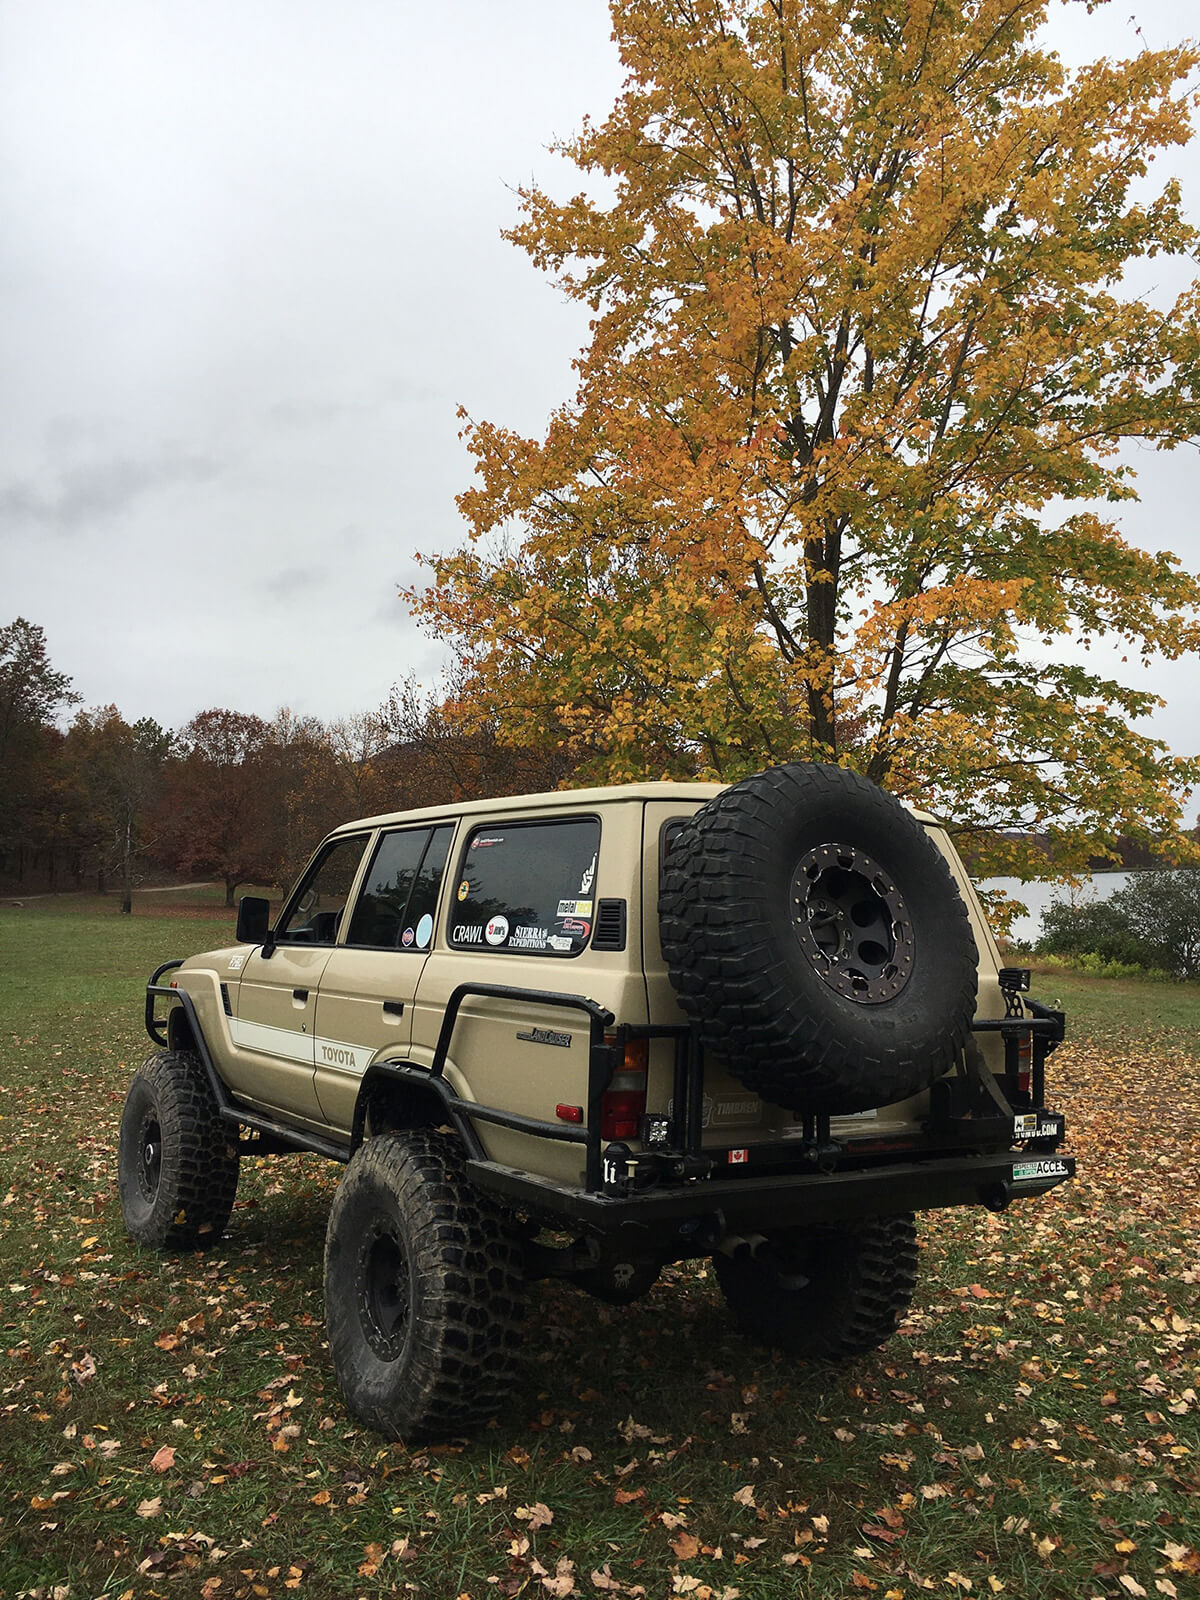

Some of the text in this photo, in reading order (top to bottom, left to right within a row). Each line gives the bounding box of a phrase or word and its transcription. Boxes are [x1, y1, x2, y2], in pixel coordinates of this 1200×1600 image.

[453, 925, 483, 943] CRAWL
[514, 925, 543, 939] SIERRA
[508, 936, 547, 949] EXPEDITIONS
[321, 1045, 357, 1067] TOYOTA
